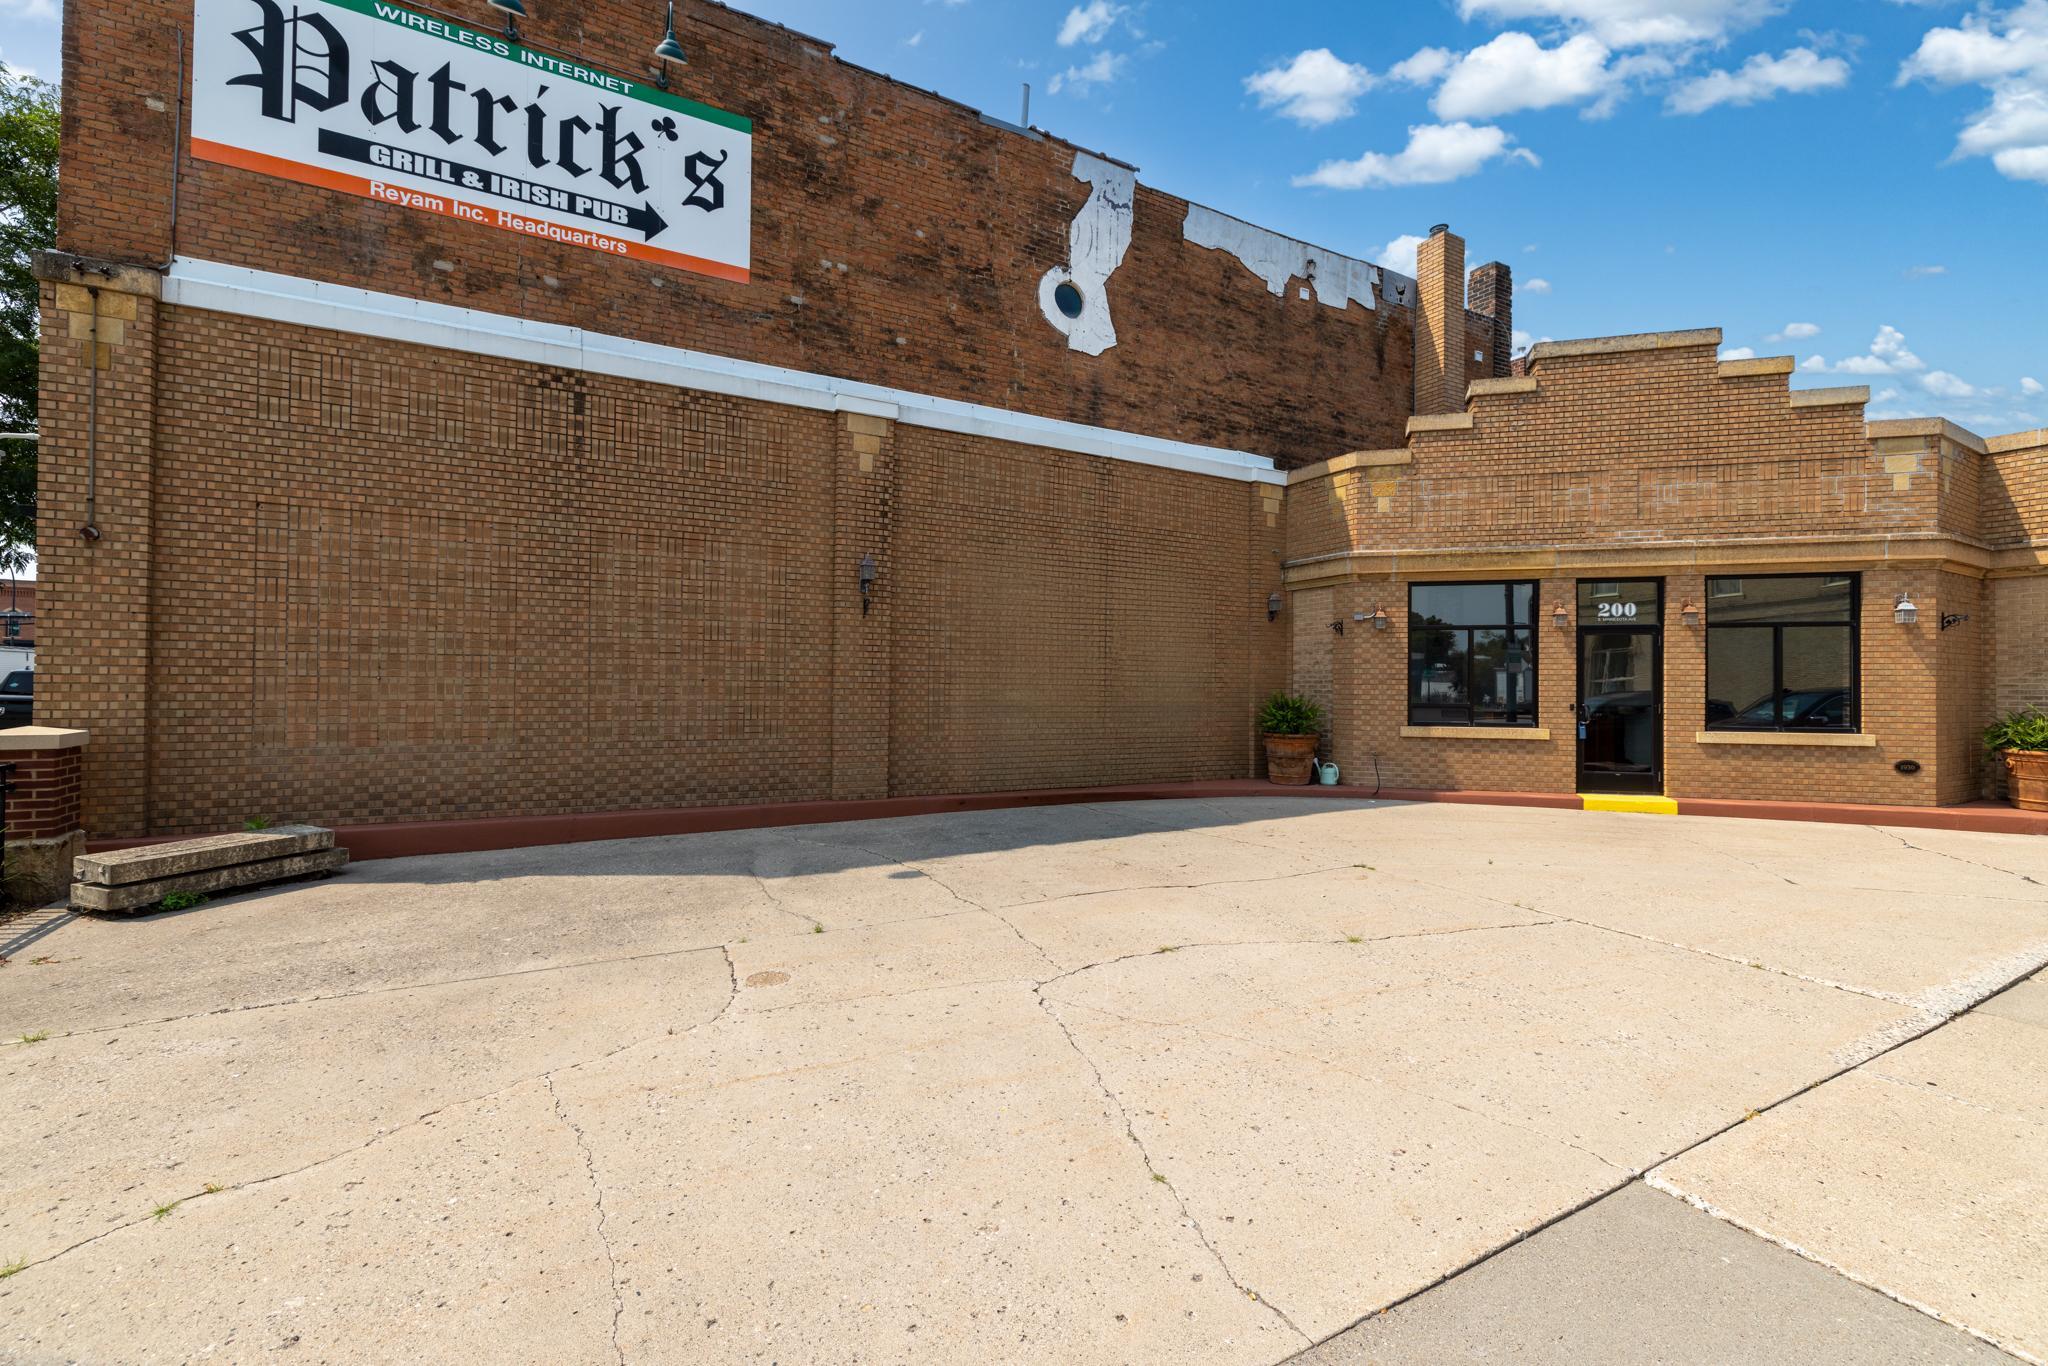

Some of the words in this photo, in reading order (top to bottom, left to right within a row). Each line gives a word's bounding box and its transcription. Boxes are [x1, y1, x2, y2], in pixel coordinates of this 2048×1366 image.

[373, 2, 510, 56] WIRELESS
[521, 50, 634, 94] INTERNET
[369, 144, 456, 183] GRILL
[461, 170, 485, 190] &
[490, 174, 569, 211] IRISH
[575, 195, 629, 225] PUB
[370, 180, 444, 212] Reyam
[453, 200, 489, 223] Inc.
[497, 210, 628, 254] Headquarters
[1597, 602, 1637, 617] 200
